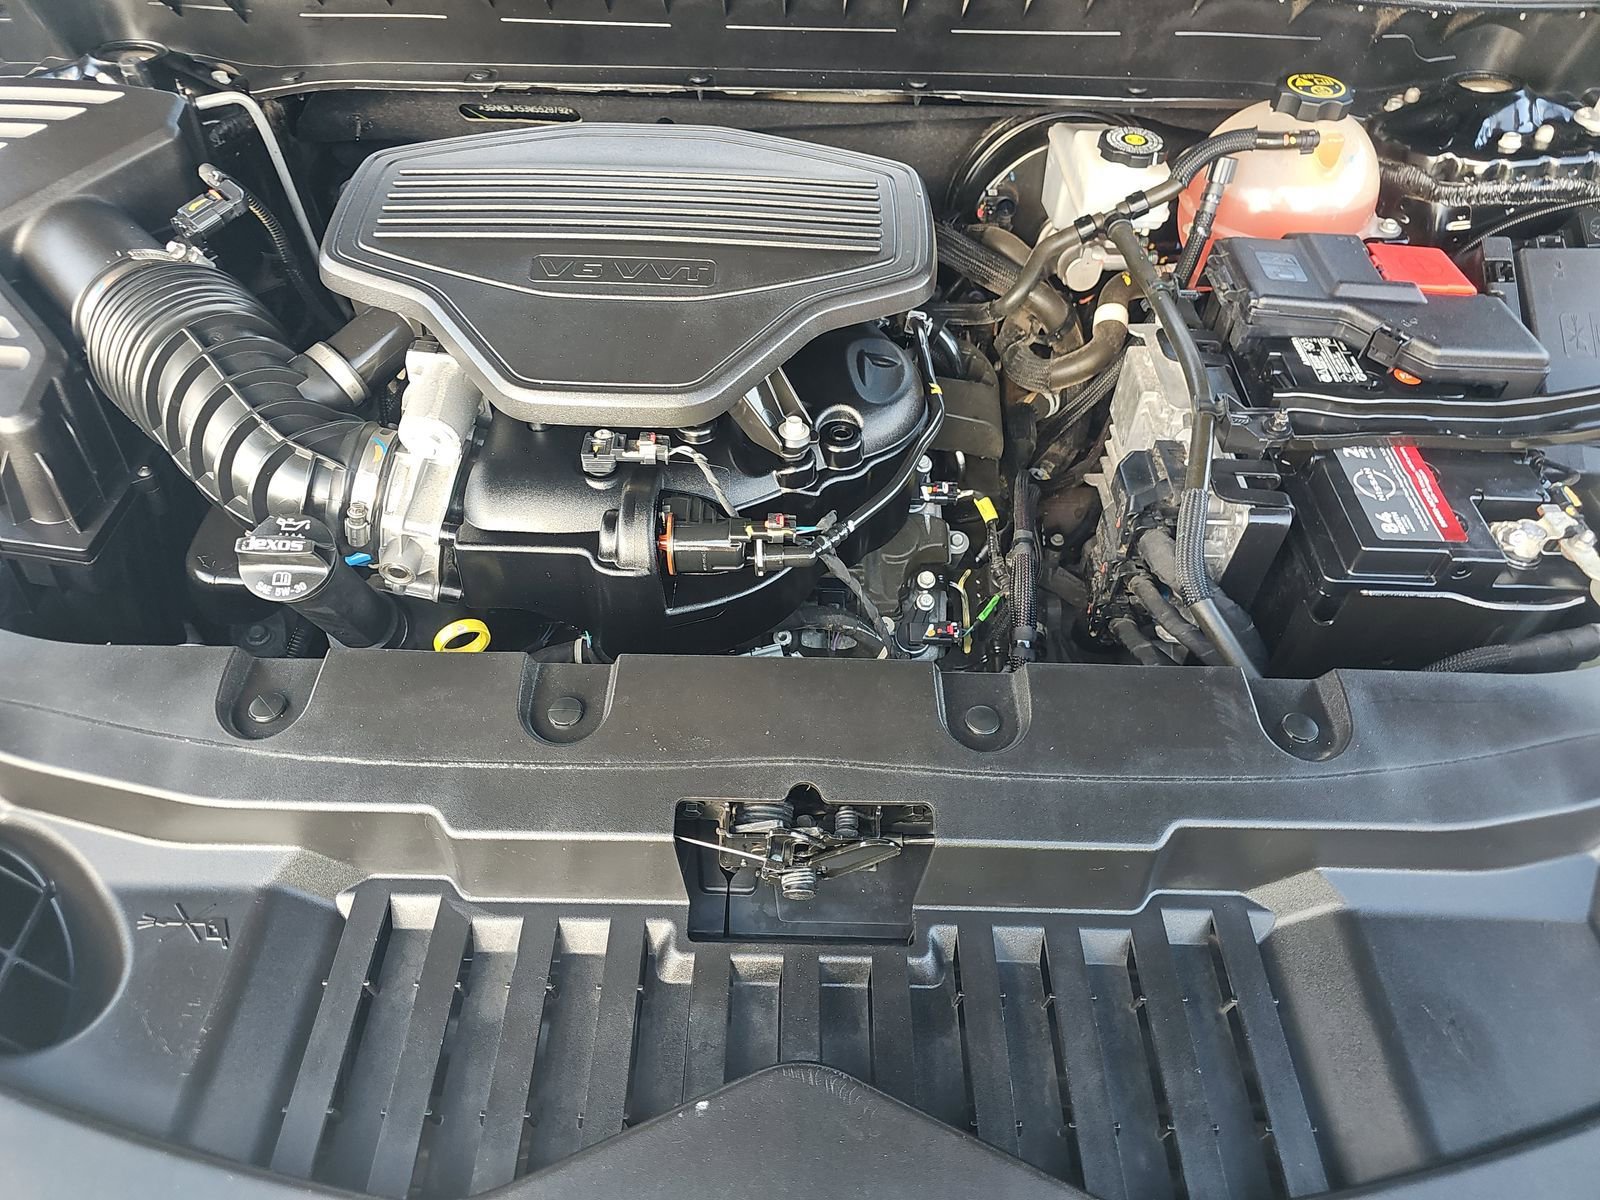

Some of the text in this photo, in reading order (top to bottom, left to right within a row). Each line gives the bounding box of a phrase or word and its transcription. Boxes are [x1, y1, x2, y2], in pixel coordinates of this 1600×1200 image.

[539, 260, 710, 282] V6 VVT
[1363, 467, 1387, 501] NISSAN
[255, 581, 307, 596] SAE 5W-30
